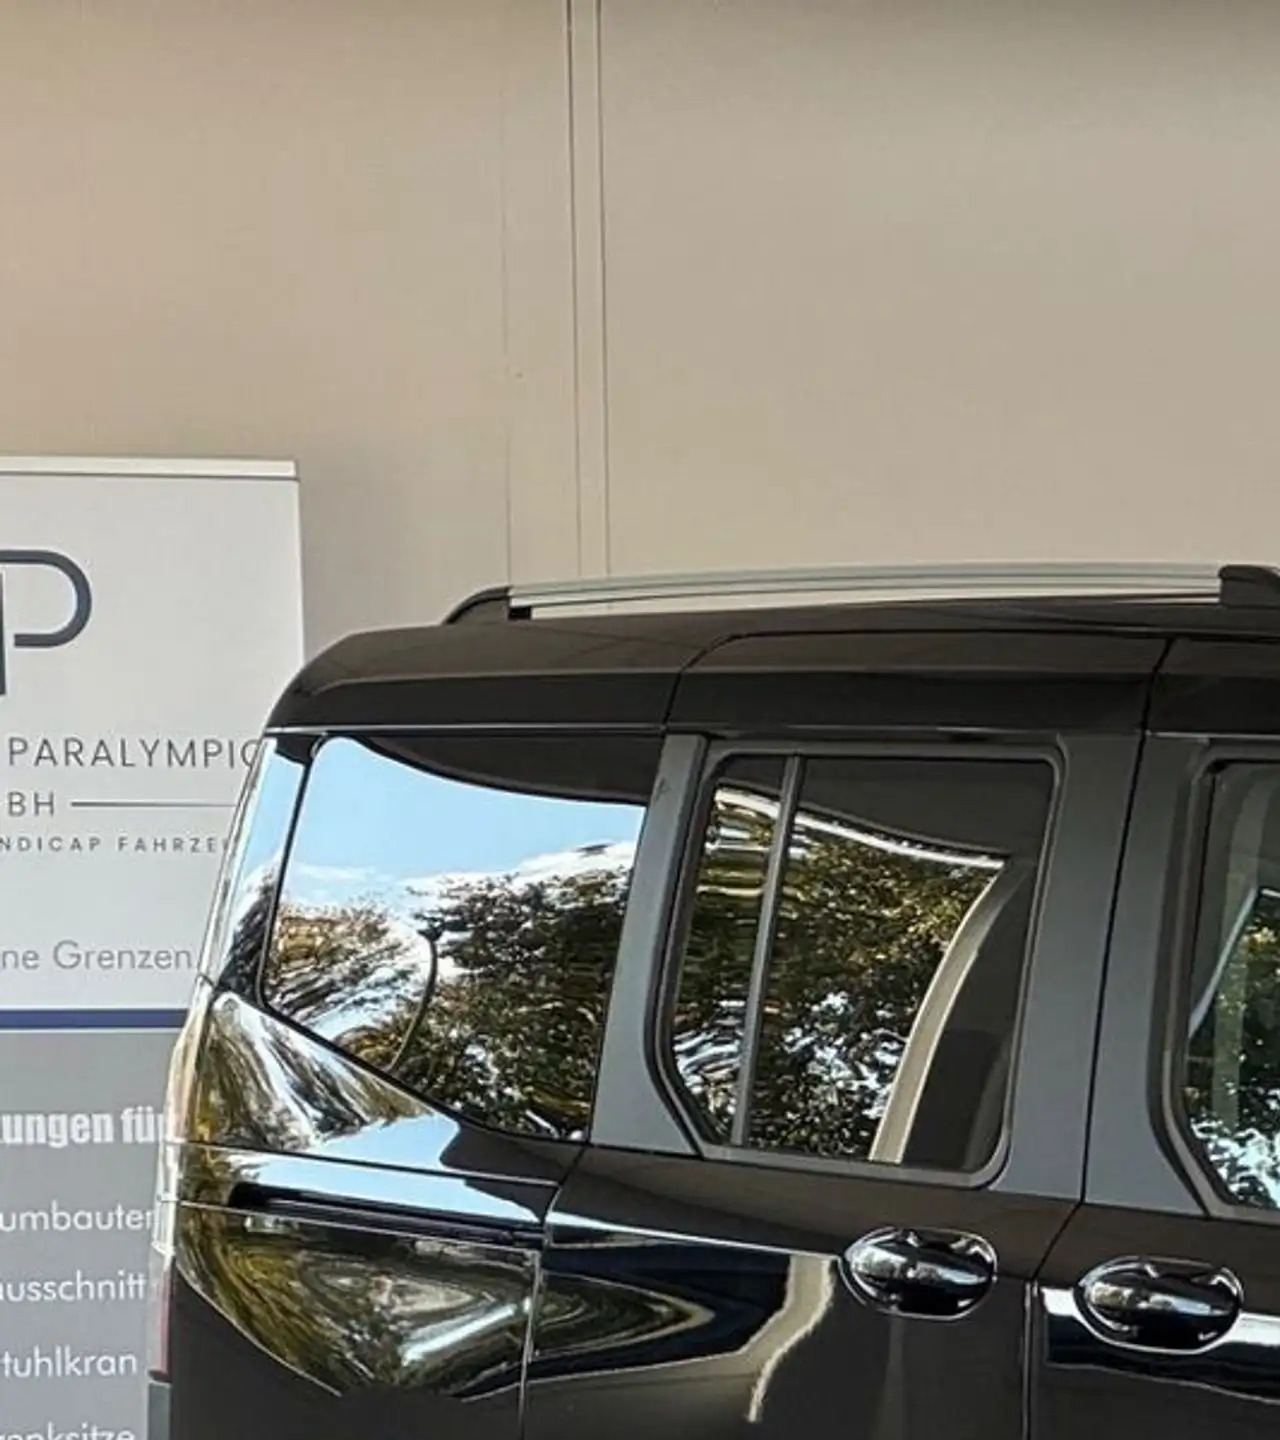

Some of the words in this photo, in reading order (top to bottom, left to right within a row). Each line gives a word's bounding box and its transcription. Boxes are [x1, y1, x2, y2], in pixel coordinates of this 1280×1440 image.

[8, 735, 262, 769] PARALYMPIC
[8, 791, 54, 816] BH
[0, 1112, 114, 1148] ungen
[0, 1268, 147, 1303] usschnitt
